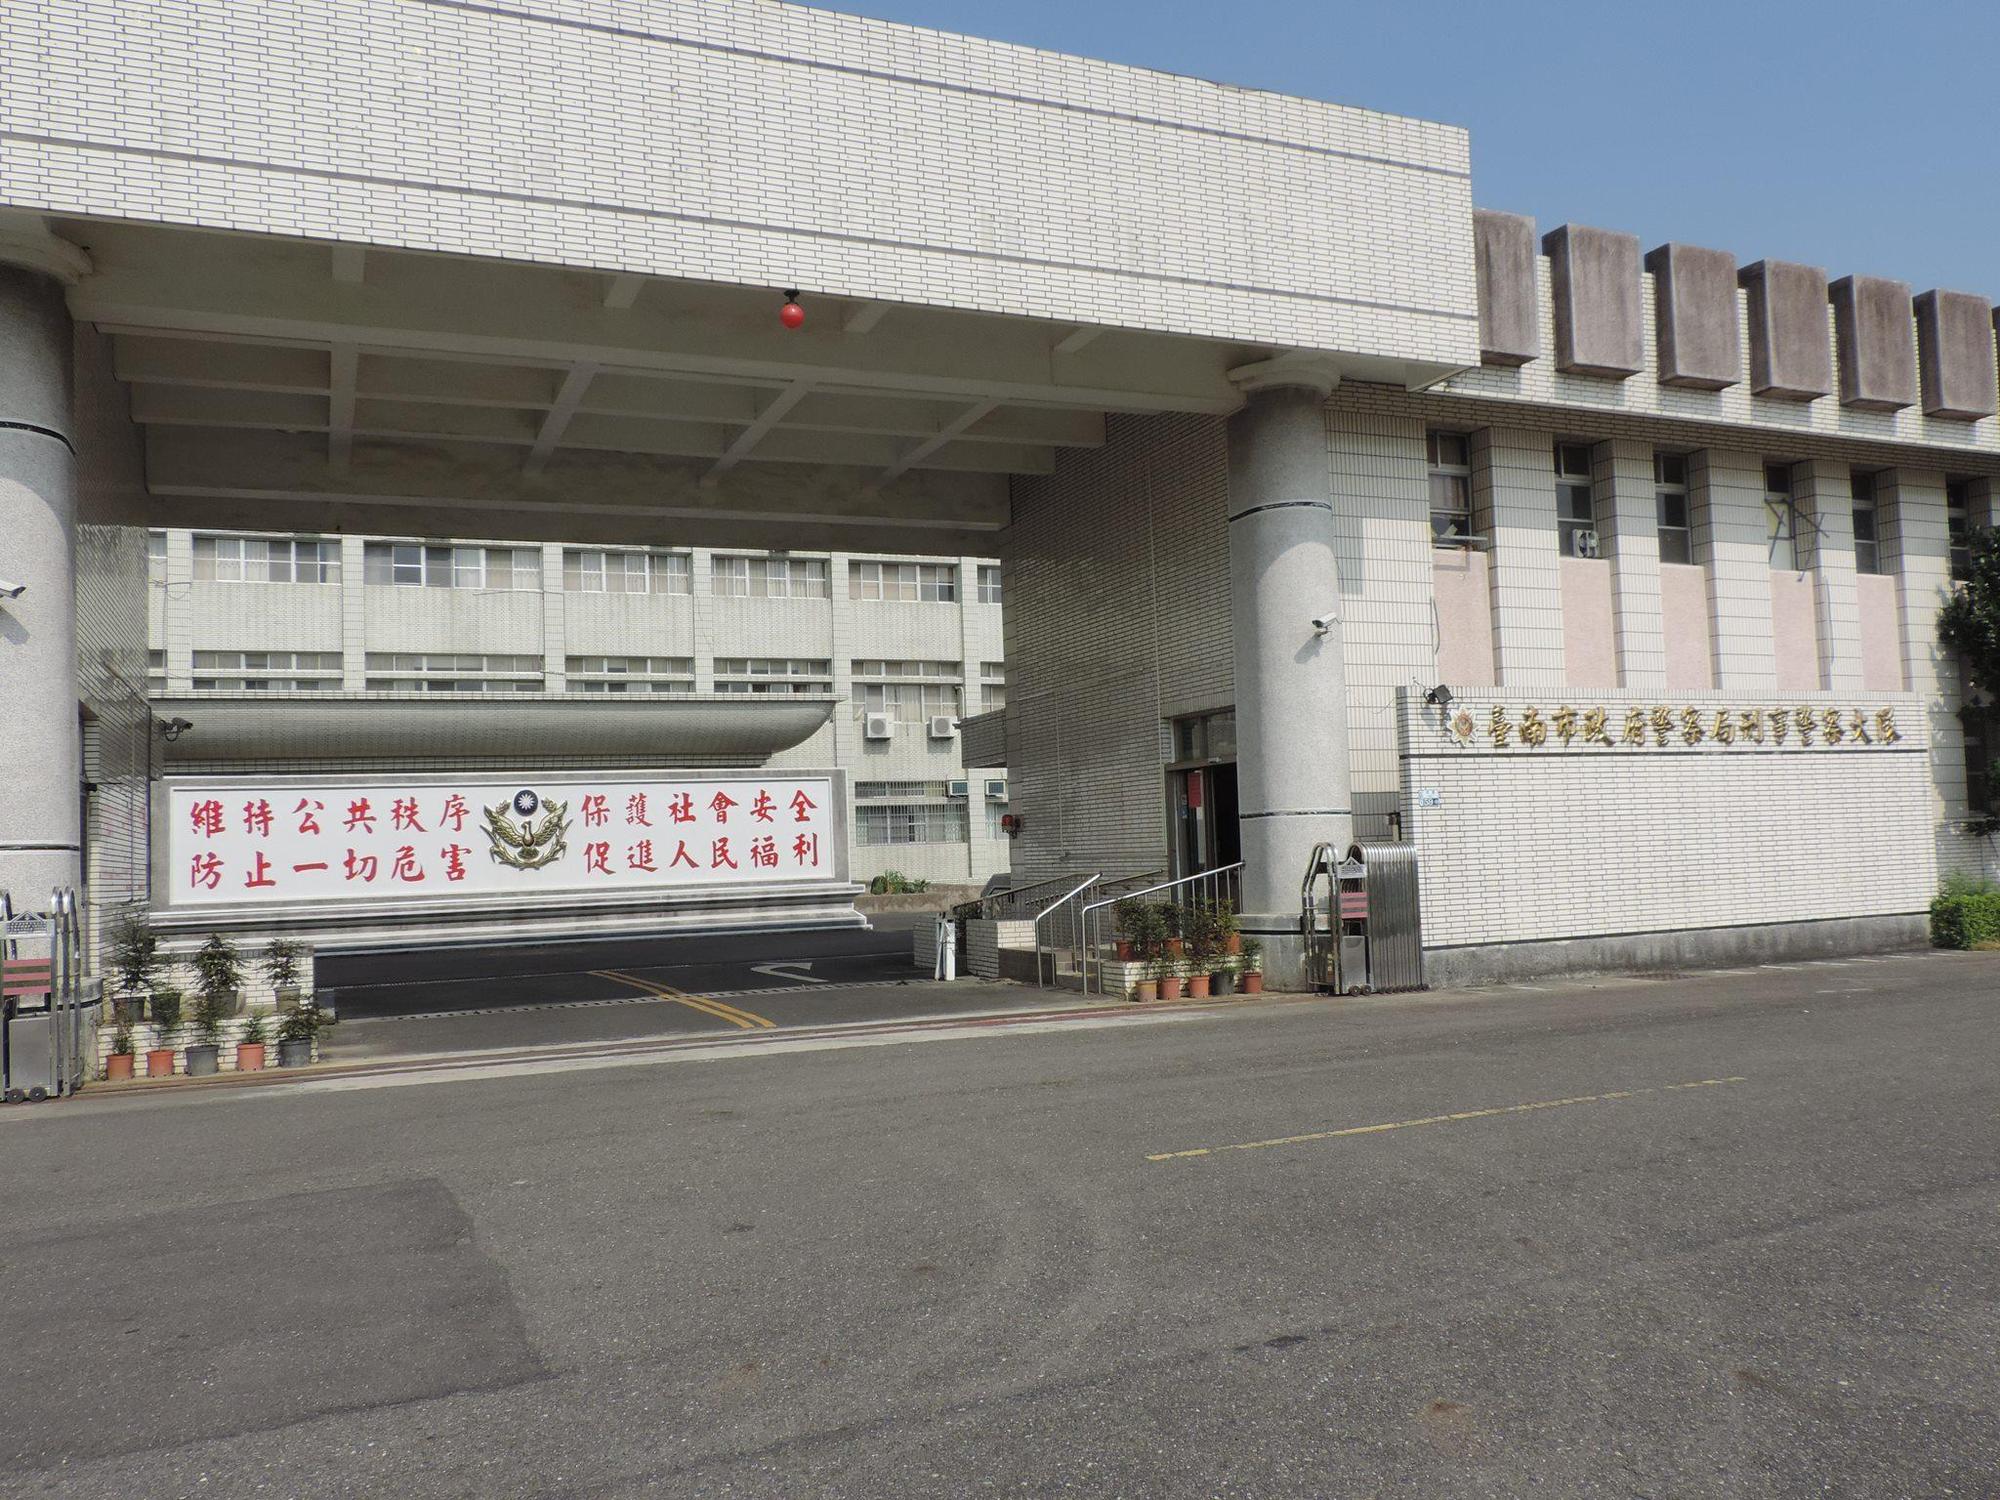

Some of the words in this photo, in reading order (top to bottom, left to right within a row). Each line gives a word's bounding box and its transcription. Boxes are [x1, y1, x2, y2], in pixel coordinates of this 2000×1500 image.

[1489, 704, 1902, 747] 臺南市政府警察局刑事警察大隊
[190, 794, 470, 838] 維持公共秩序
[581, 789, 818, 828] 保護社會安全
[190, 843, 472, 890] 防止一切危害
[583, 832, 819, 876] 促進人民福利
